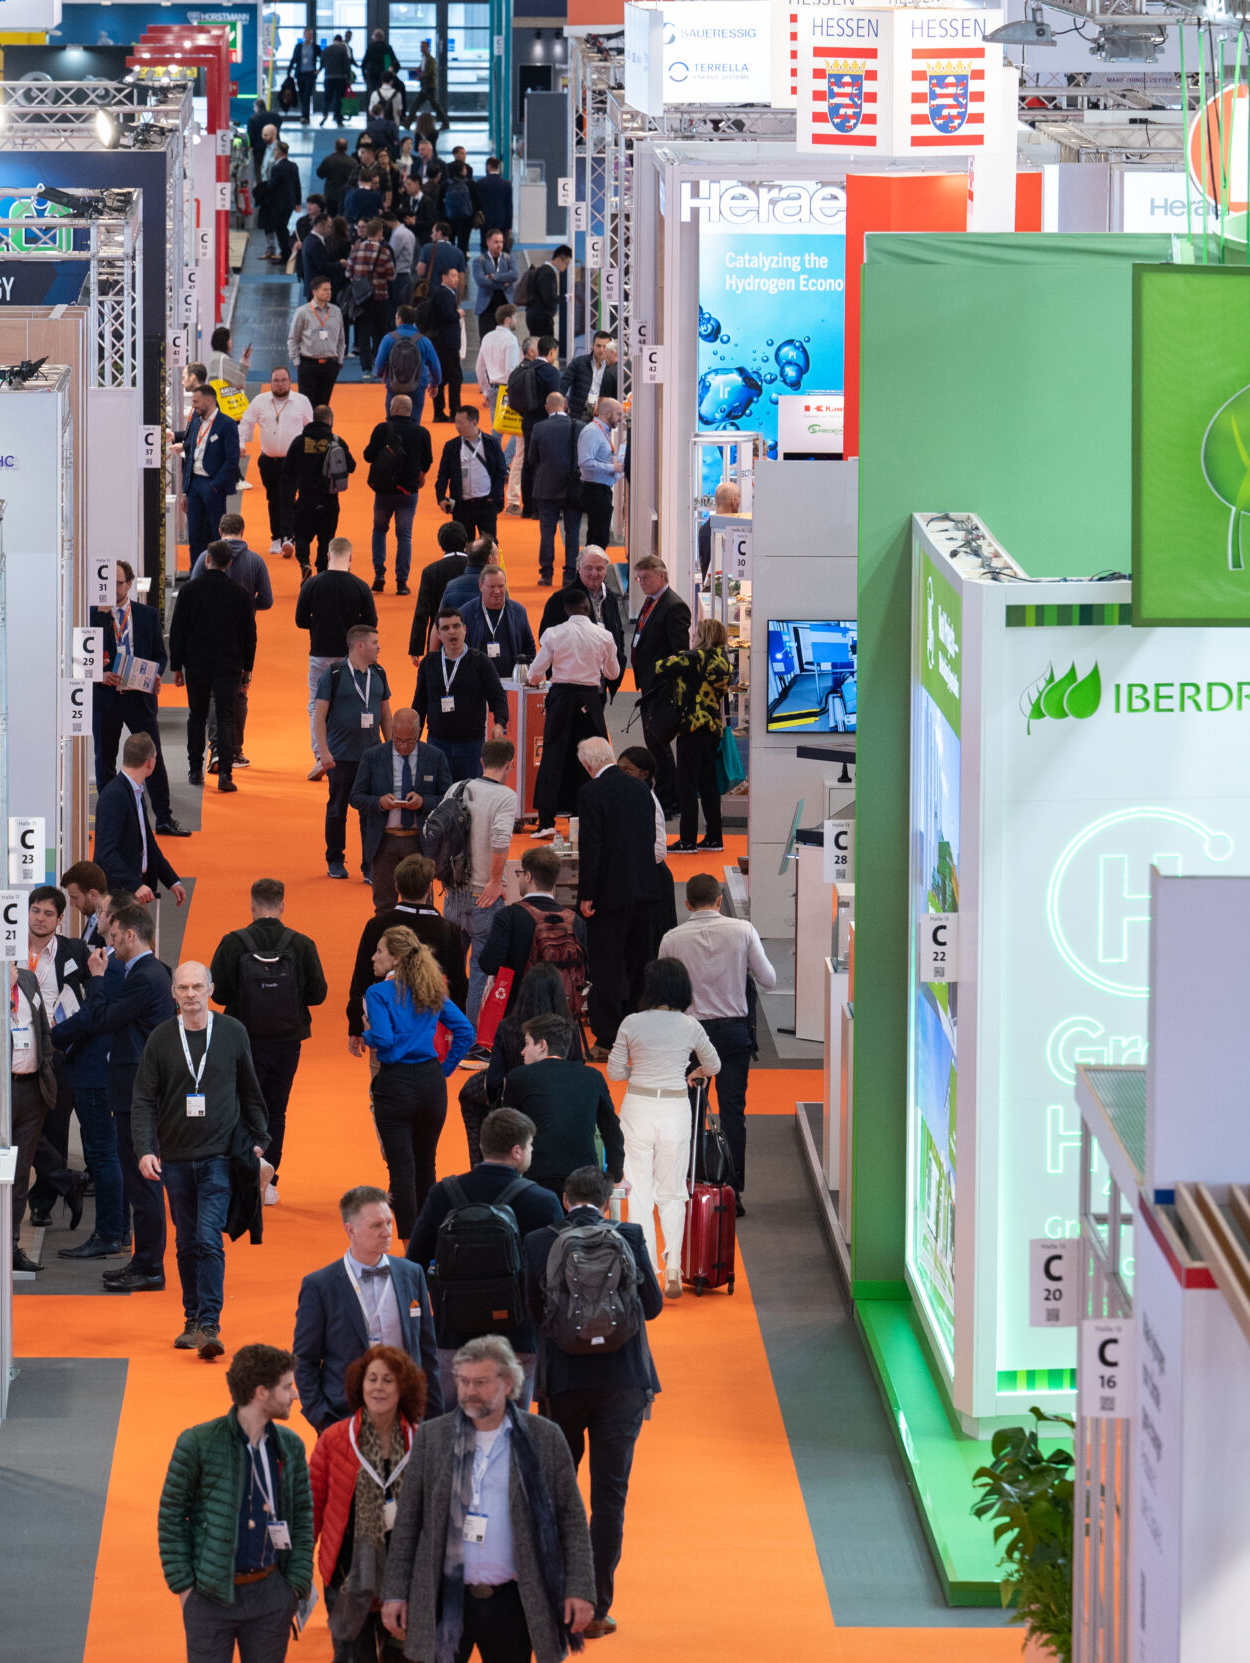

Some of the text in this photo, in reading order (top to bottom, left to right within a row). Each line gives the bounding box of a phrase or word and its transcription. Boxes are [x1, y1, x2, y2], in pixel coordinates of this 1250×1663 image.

[681, 28, 757, 39] SAUERESSIG
[812, 17, 879, 38] HESSEN
[911, 18, 987, 39] HESSEN
[694, 63, 749, 72] TERRELLA
[219, 186, 227, 196] C
[561, 182, 569, 192] C
[574, 206, 582, 216] C
[200, 232, 208, 244] C
[591, 241, 599, 252] C
[725, 251, 828, 272] Catalyzing the
[188, 272, 196, 283] C
[605, 273, 614, 285] C
[725, 274, 844, 294] Hydrogen Econo
[184, 294, 192, 305] C
[637, 325, 646, 337] C
[172, 336, 181, 348] C
[648, 351, 657, 364] C
[719, 383, 731, 400] Ir
[144, 432, 154, 446] C
[145, 448, 153, 456] 37
[737, 540, 747, 556] C
[737, 558, 746, 567] 30
[97, 564, 109, 581] C
[98, 583, 108, 592] 31
[82, 636, 95, 654] C
[82, 657, 95, 666] 29
[70, 687, 84, 707] C
[1114, 682, 1250, 714] IBERDR
[71, 710, 83, 719] 25
[20, 829, 35, 850] C
[834, 830, 849, 851] C
[21, 854, 34, 865] 23
[834, 855, 848, 865] 28
[3, 903, 18, 925] C
[5, 930, 16, 940] 21
[932, 924, 948, 947] C
[932, 951, 947, 962] 22
[1043, 1254, 1064, 1283] C
[1043, 1288, 1063, 1302] 20
[1097, 1337, 1120, 1368] C
[1099, 1375, 1117, 1389] 16
